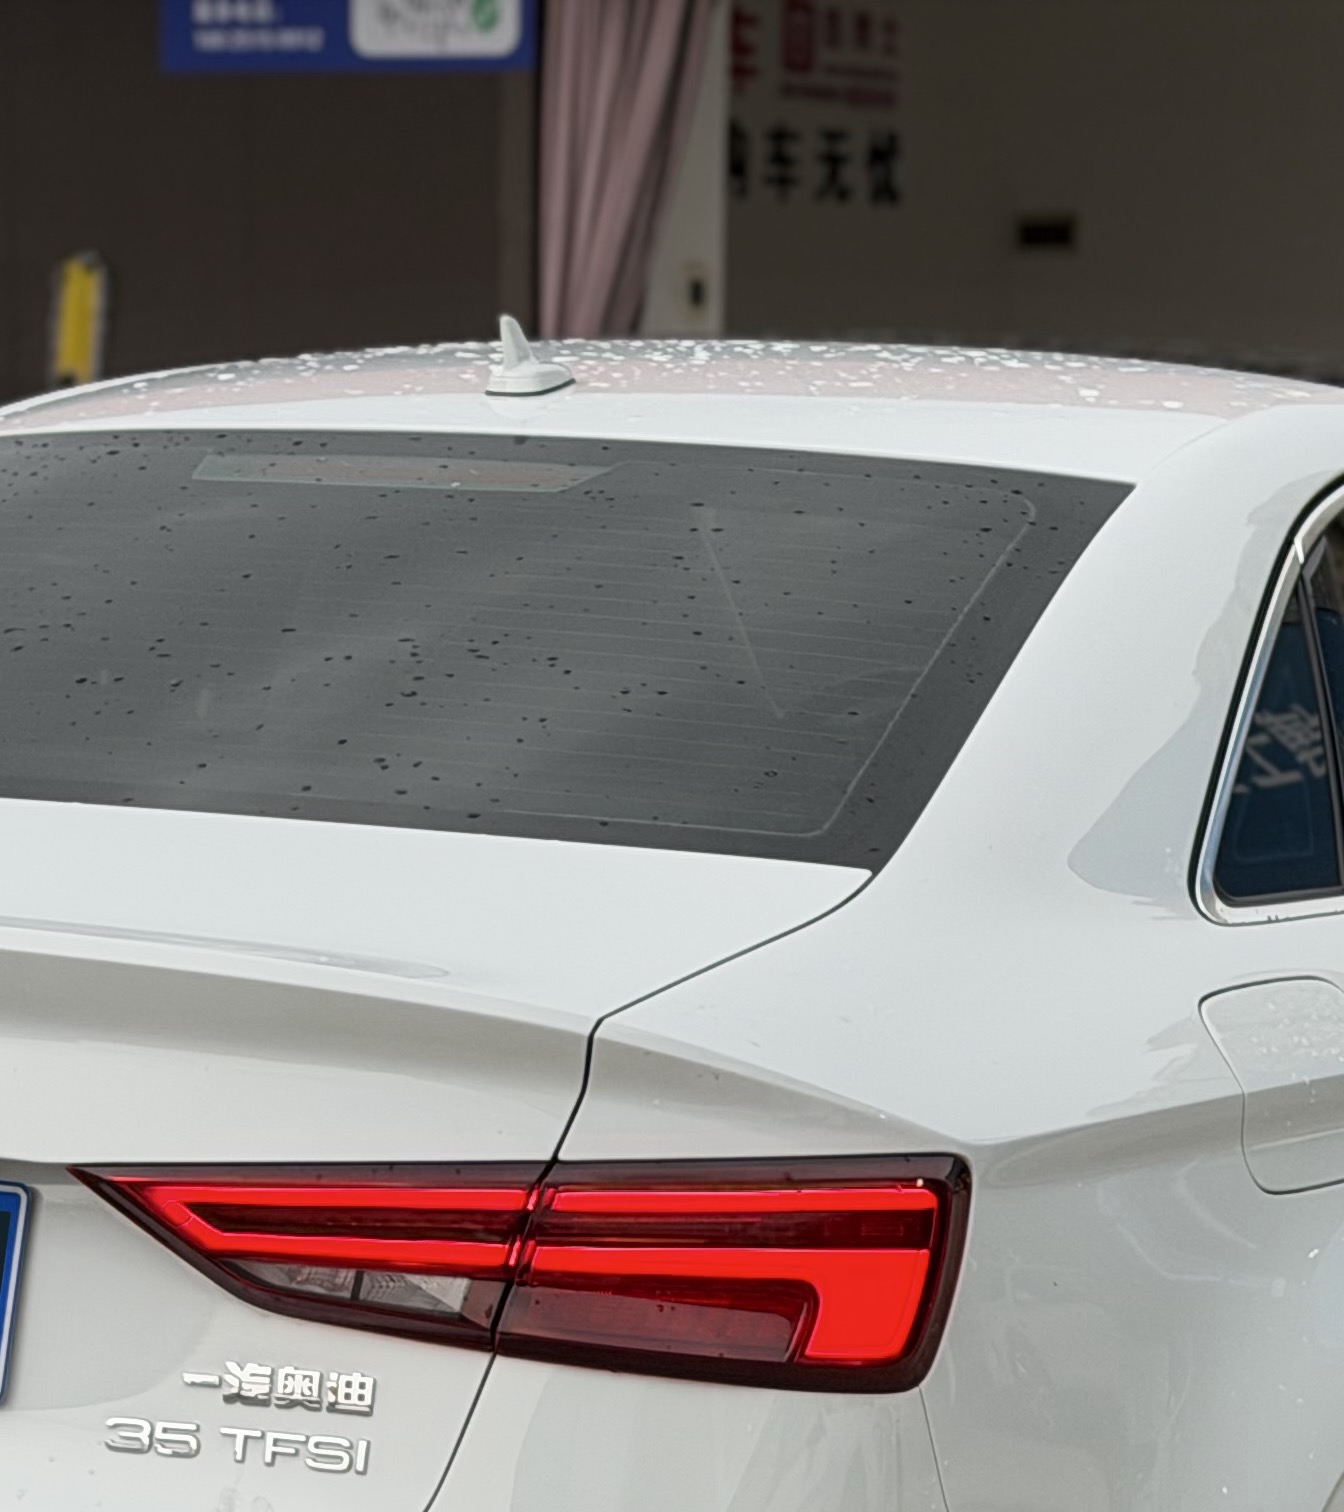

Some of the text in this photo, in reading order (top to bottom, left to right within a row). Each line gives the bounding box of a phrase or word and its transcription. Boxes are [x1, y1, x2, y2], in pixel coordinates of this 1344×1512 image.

[182, 1360, 377, 1417] 一汽奥迪
[104, 1416, 371, 1476] 35 TFSI
